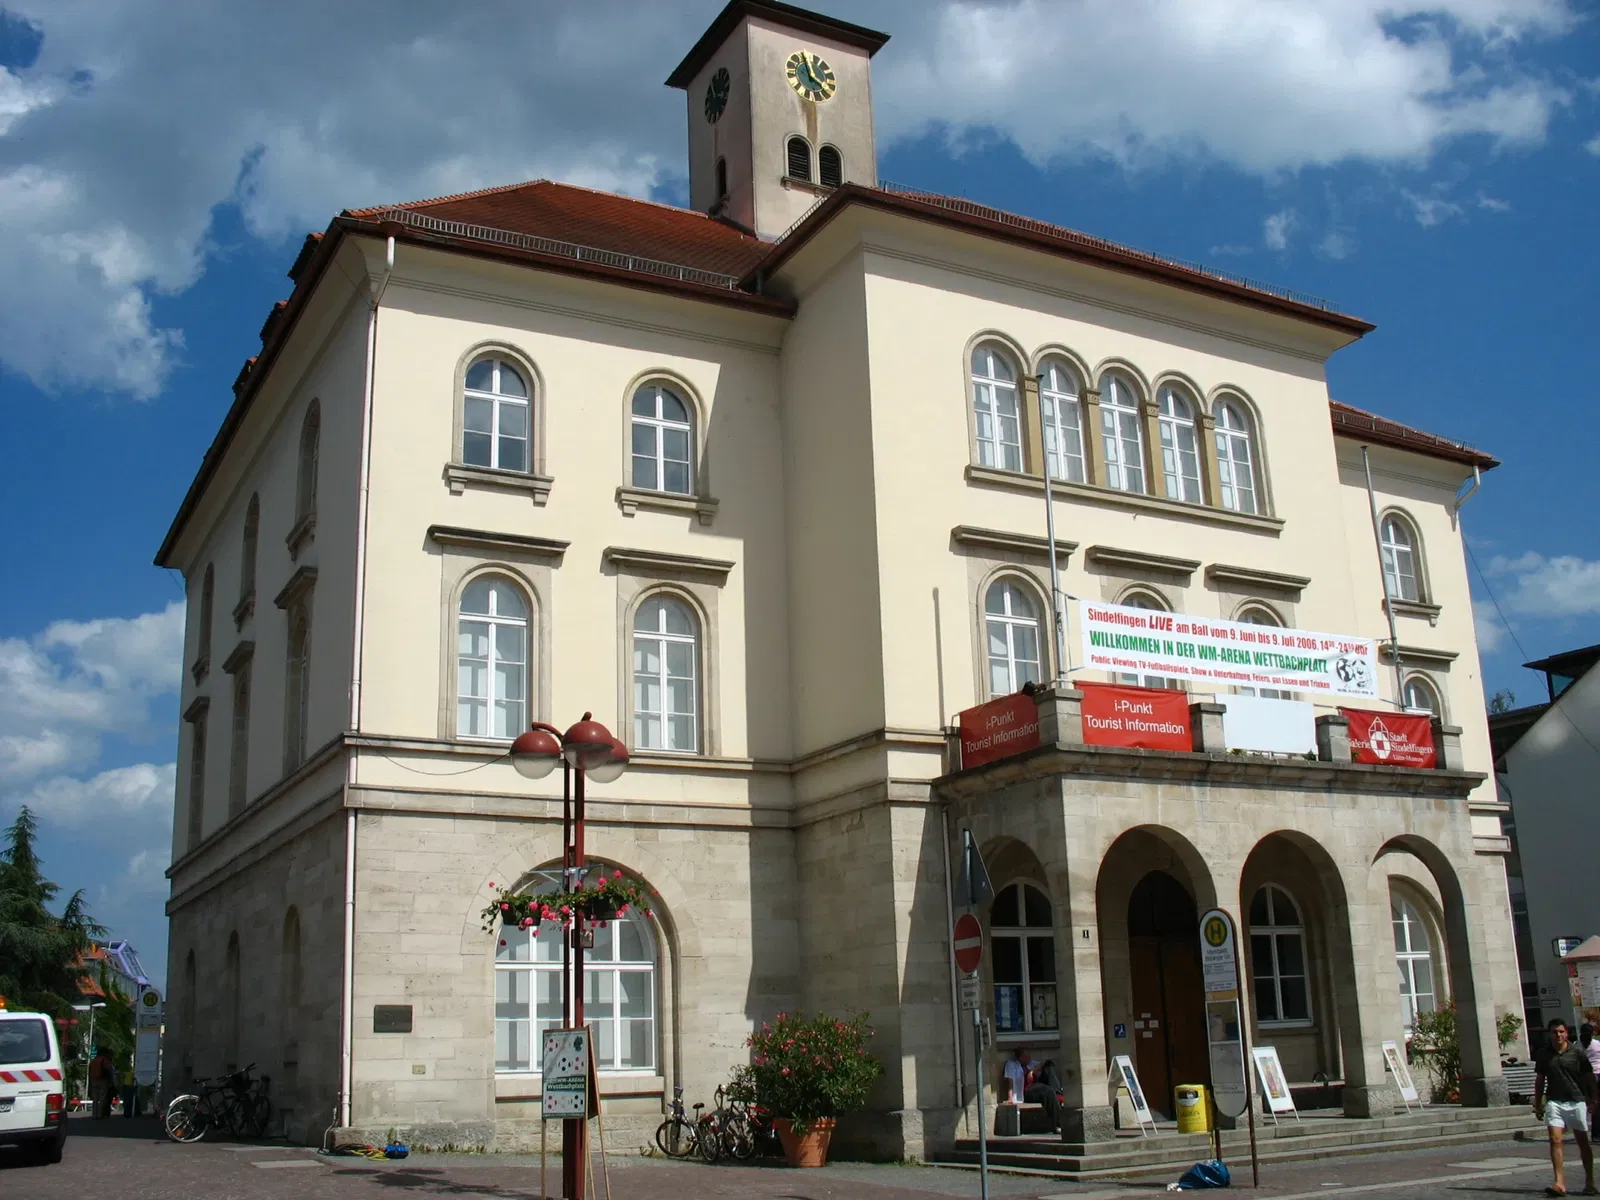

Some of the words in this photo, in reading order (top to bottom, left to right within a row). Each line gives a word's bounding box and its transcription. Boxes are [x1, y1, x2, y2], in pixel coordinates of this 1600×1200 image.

[1088, 608, 1146, 628] Sindelfingen
[1149, 615, 1173, 631] LIVE
[1176, 623, 1190, 634] am
[1192, 623, 1208, 636] Ball
[1210, 628, 1228, 639] vom
[1230, 628, 1238, 640] 9.
[1240, 630, 1255, 642] Juni
[1257, 632, 1271, 644] bis
[1272, 634, 1280, 645] 9.
[1282, 635, 1295, 647] Juli
[1089, 630, 1160, 654] WILLKOMMEN
[1163, 640, 1174, 656] IN
[1176, 641, 1195, 658] DER
[1197, 644, 1252, 665] WM-ARENA
[1252, 651, 1329, 673] WETTBACHPLATZ
[1091, 654, 1111, 665] Public
[1112, 657, 1137, 669] Viewing
[1191, 667, 1206, 676] Show
[1272, 676, 1281, 685] gut
[1282, 677, 1298, 686] Essen
[1299, 679, 1309, 687] und
[1310, 680, 1330, 689] Trinken
[1114, 700, 1153, 714] i-Punkt
[986, 710, 1015, 730] i-Punkt
[1085, 714, 1122, 730] Tourist
[1125, 718, 1185, 734] Information
[966, 735, 992, 753] Tourist
[1389, 732, 1408, 742] Stadt
[1391, 742, 1433, 755] Sindelfingen
